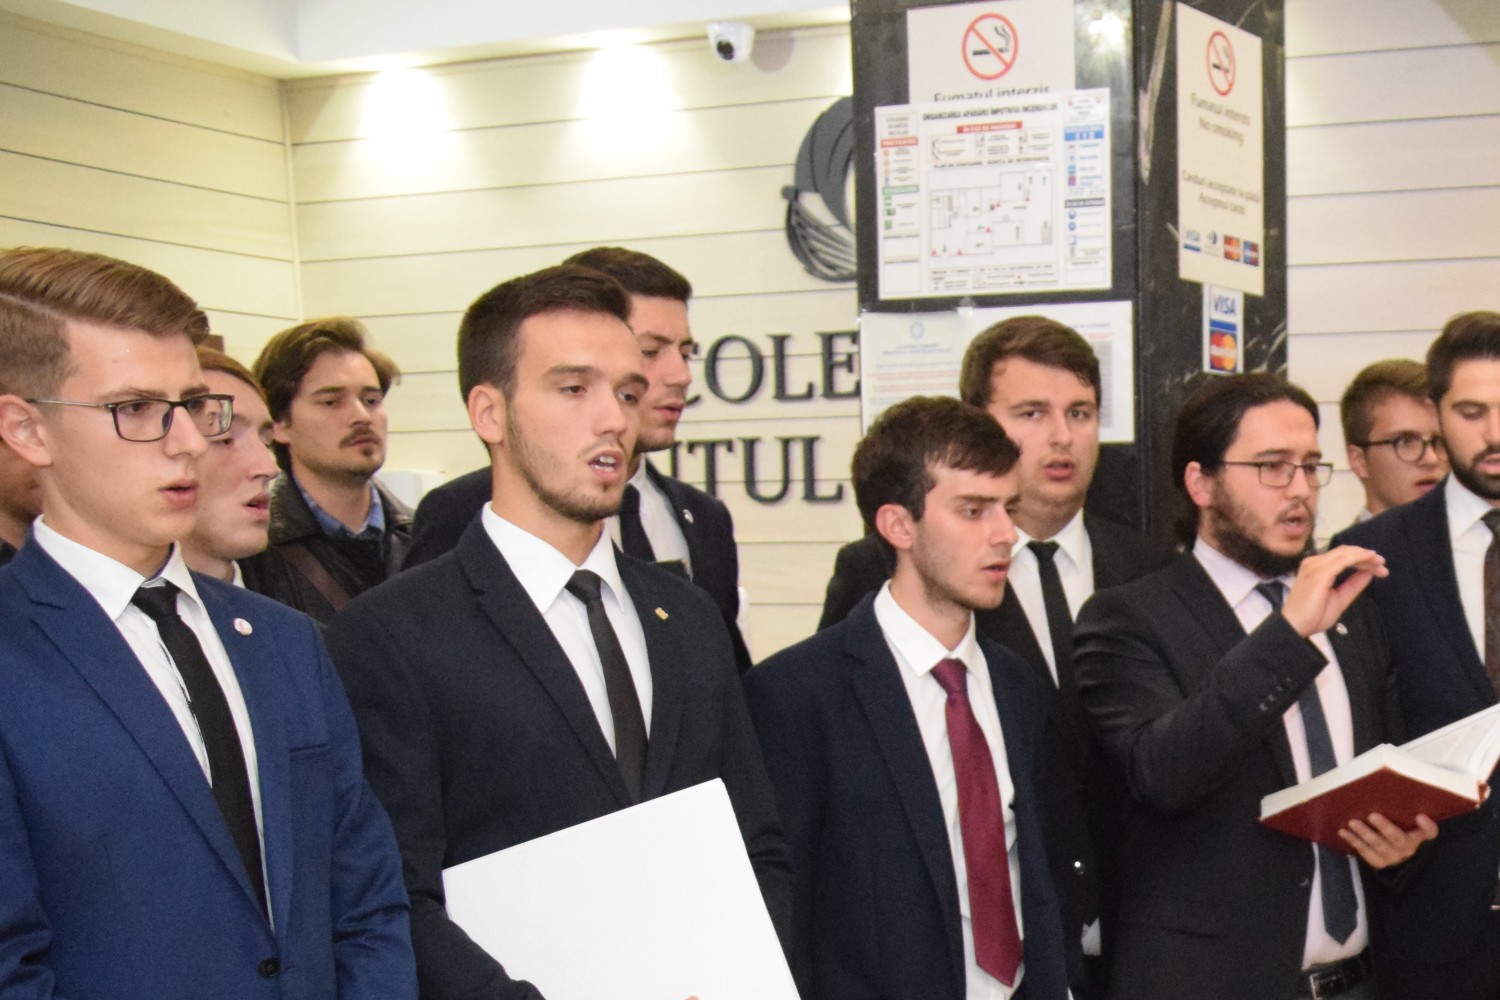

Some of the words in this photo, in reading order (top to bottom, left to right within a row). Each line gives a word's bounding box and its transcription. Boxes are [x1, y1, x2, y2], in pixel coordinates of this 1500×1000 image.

[1199, 116, 1212, 131] No
[1213, 294, 1236, 315] VISA
[686, 329, 860, 406] OLE
